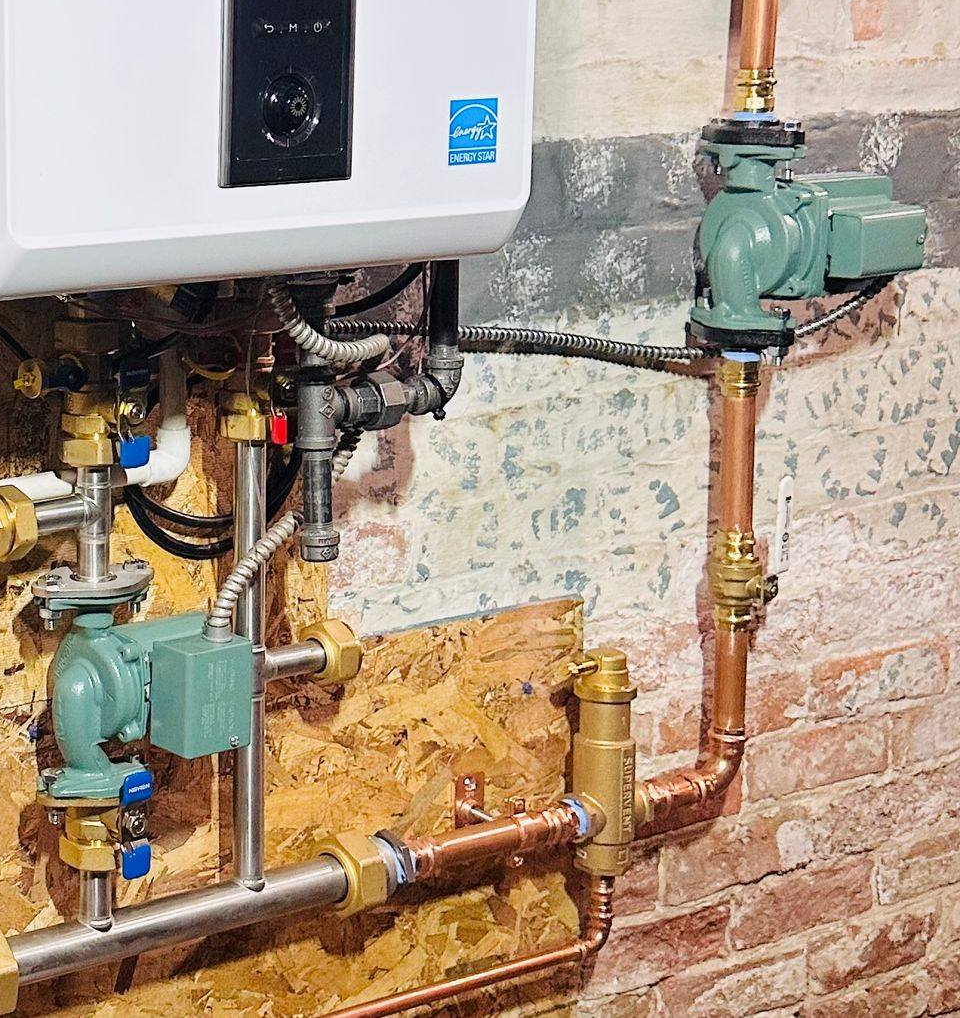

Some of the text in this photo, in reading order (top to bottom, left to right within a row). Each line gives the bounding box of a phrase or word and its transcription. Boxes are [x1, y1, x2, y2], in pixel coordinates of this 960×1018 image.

[289, 23, 297, 33] M
[450, 150, 495, 164] ENERGY STAR
[621, 756, 635, 833] SUPERVENT
